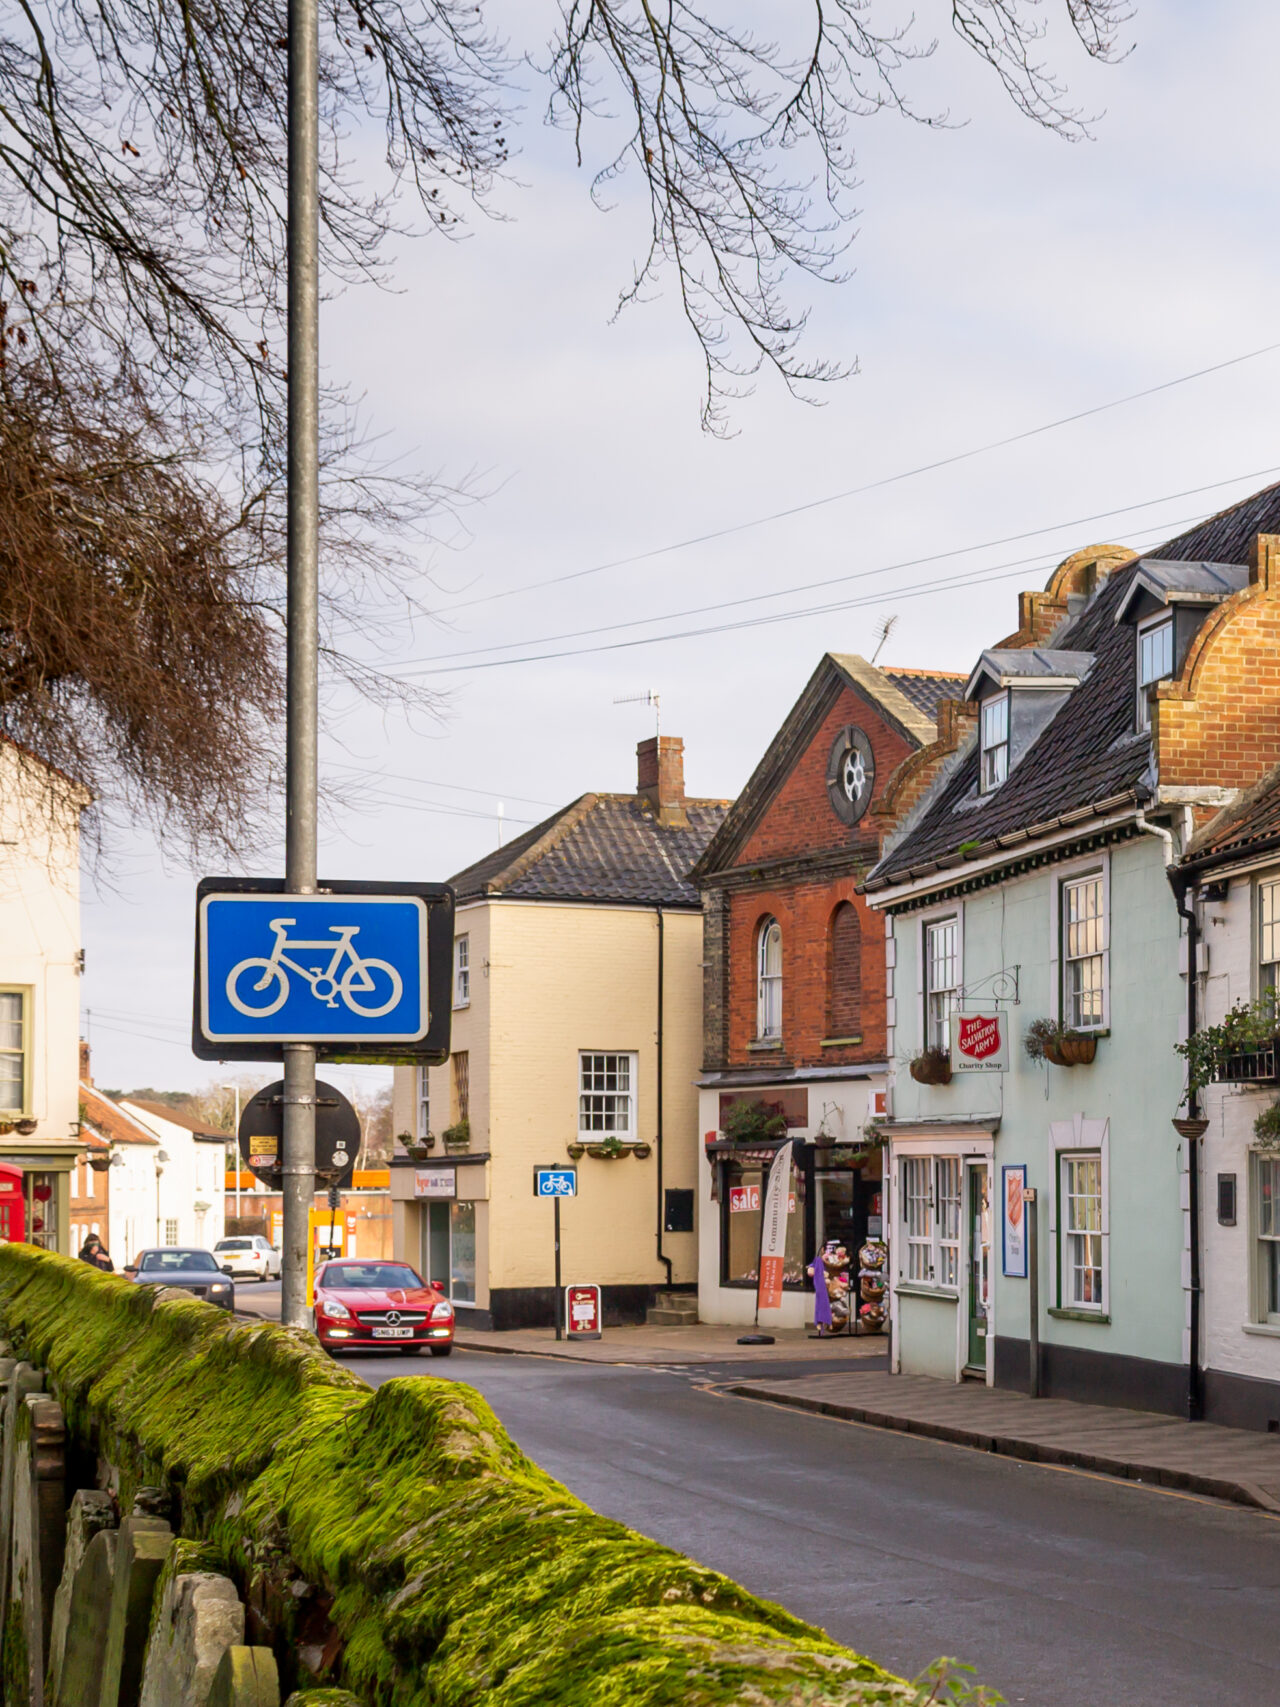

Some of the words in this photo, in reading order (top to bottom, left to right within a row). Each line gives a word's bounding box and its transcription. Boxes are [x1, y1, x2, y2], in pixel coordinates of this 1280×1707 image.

[961, 1020, 996, 1050] SALVATION
[966, 1019, 982, 1035] THE
[974, 1034, 995, 1056] ARMY
[732, 1188, 759, 1210] sale
